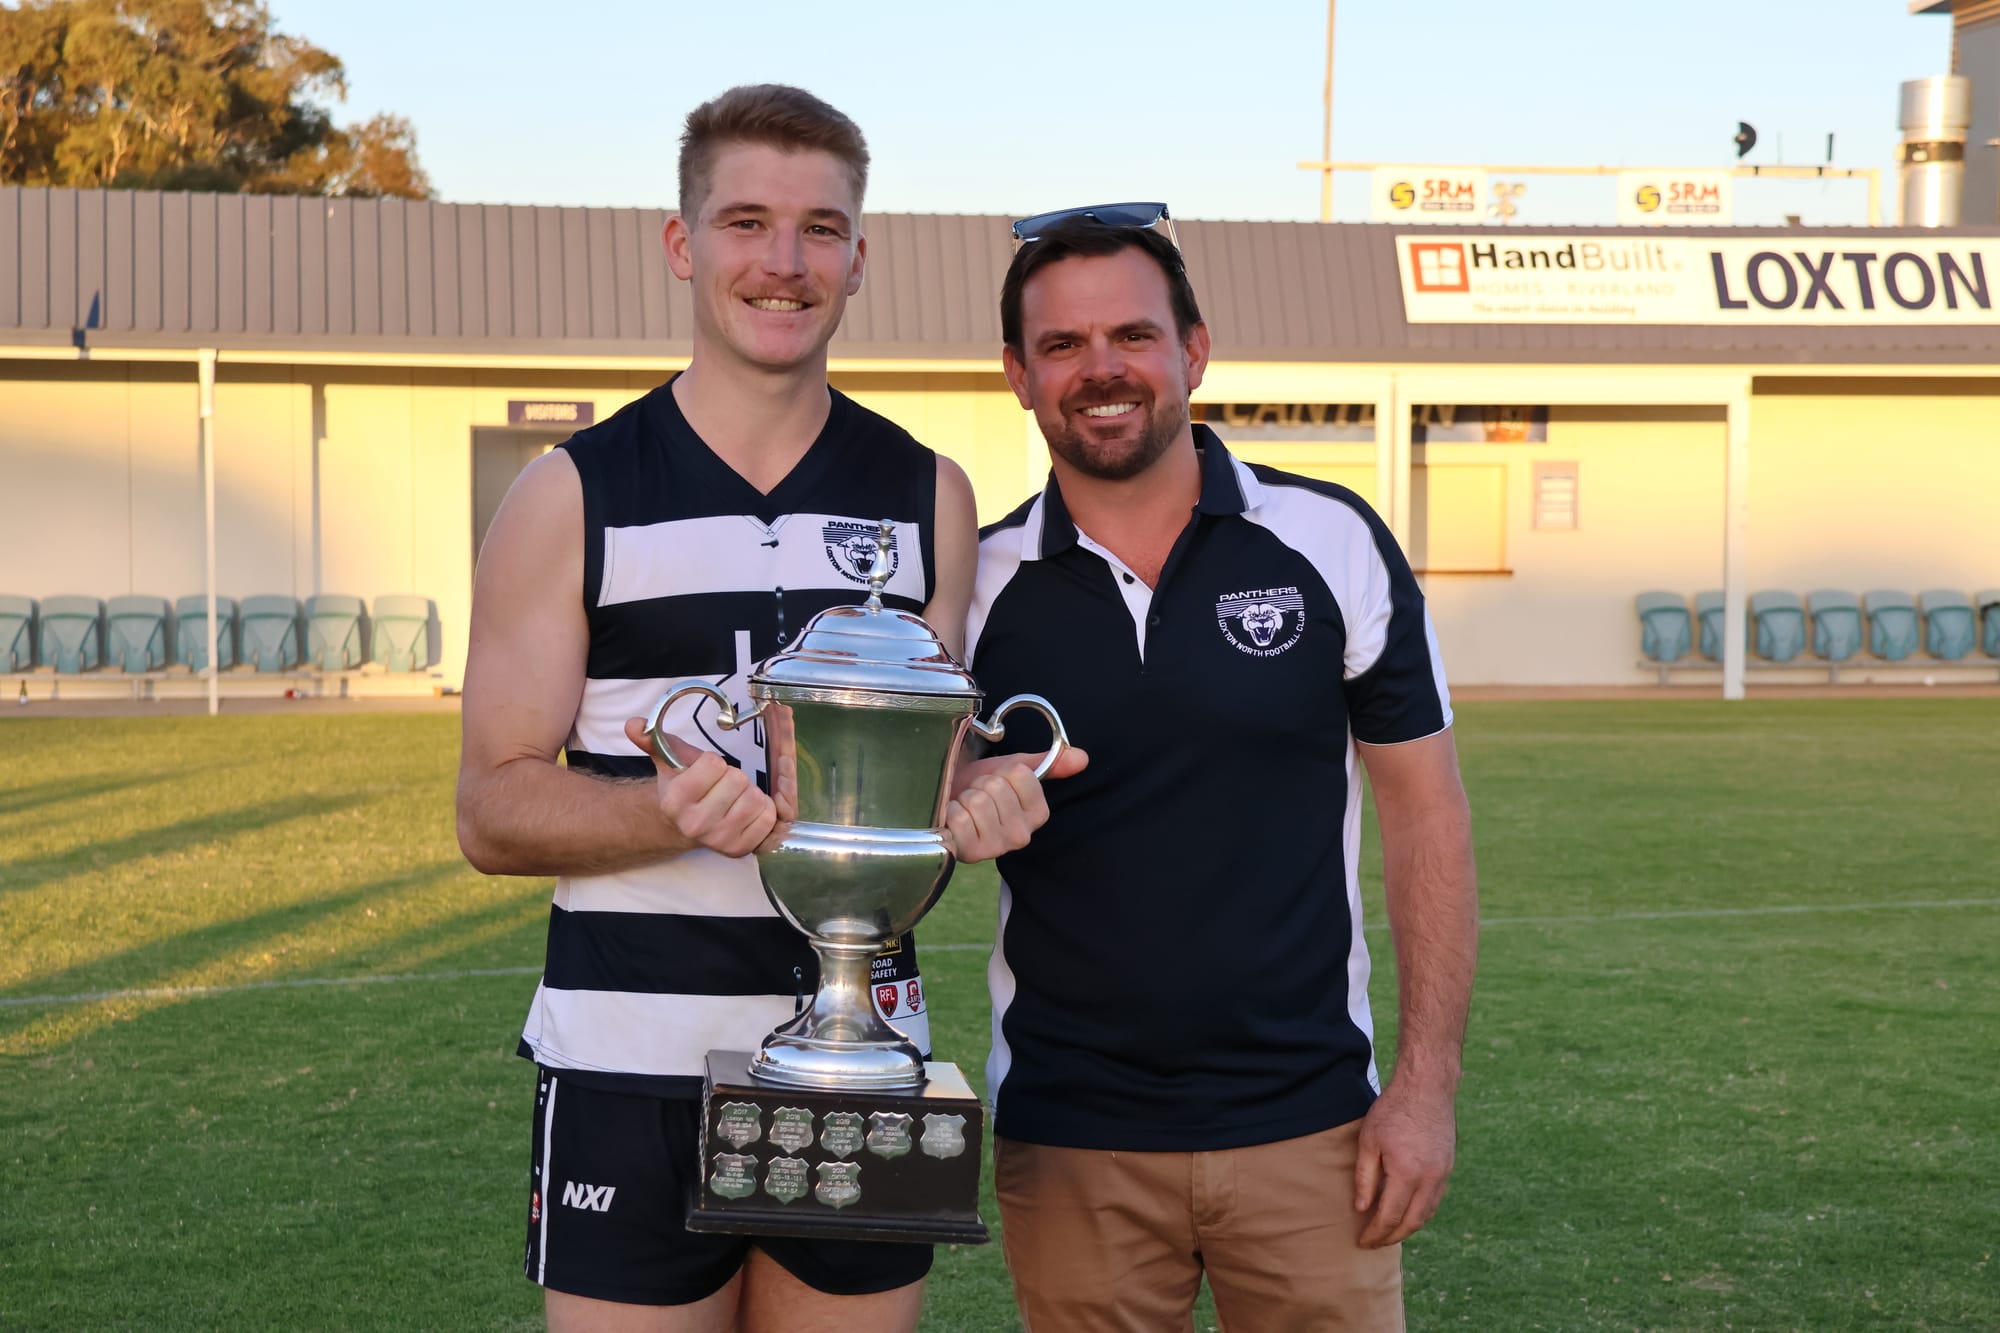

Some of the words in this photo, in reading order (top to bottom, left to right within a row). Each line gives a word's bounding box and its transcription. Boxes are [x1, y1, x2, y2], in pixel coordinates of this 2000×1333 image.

[1422, 179, 1474, 199] SRM
[1669, 181, 1720, 201] SRM
[1710, 251, 1992, 310] LOXTON
[828, 521, 881, 533] PANTHE
[1219, 586, 1298, 602] PANTHERS
[1218, 618, 1237, 646] LOXTON
[1236, 642, 1263, 657] NORTH
[1264, 633, 1301, 657] FOOTBALL
[1296, 610, 1306, 632] CLUB
[871, 968, 897, 979] SAFETY
[879, 989, 896, 1002] RFL
